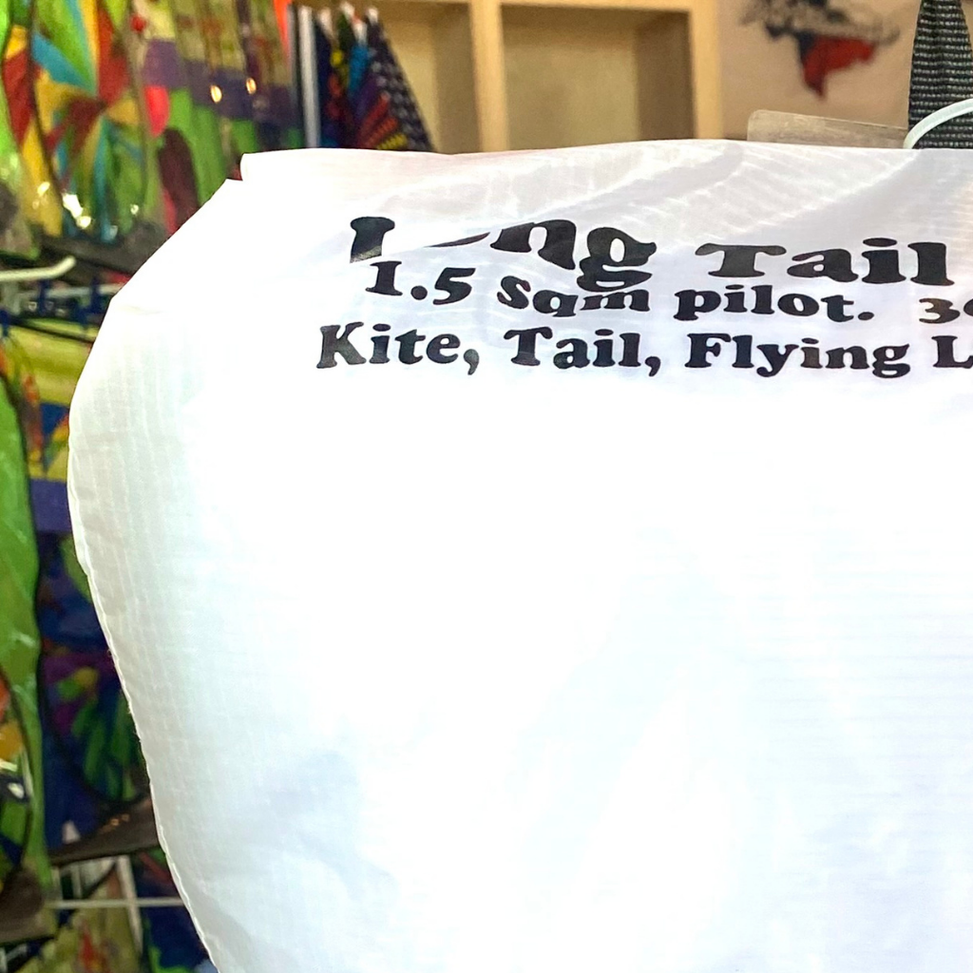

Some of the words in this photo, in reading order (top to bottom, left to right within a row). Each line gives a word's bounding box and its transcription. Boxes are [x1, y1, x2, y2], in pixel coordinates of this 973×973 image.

[350, 216, 656, 292] ng
[695, 237, 954, 287] Tail
[366, 261, 476, 305] 1.5
[497, 276, 650, 318] Sqm
[673, 285, 875, 322] pilot.
[317, 322, 479, 375] Kite,
[504, 327, 660, 376] Tail,
[685, 333, 911, 379] Flying
